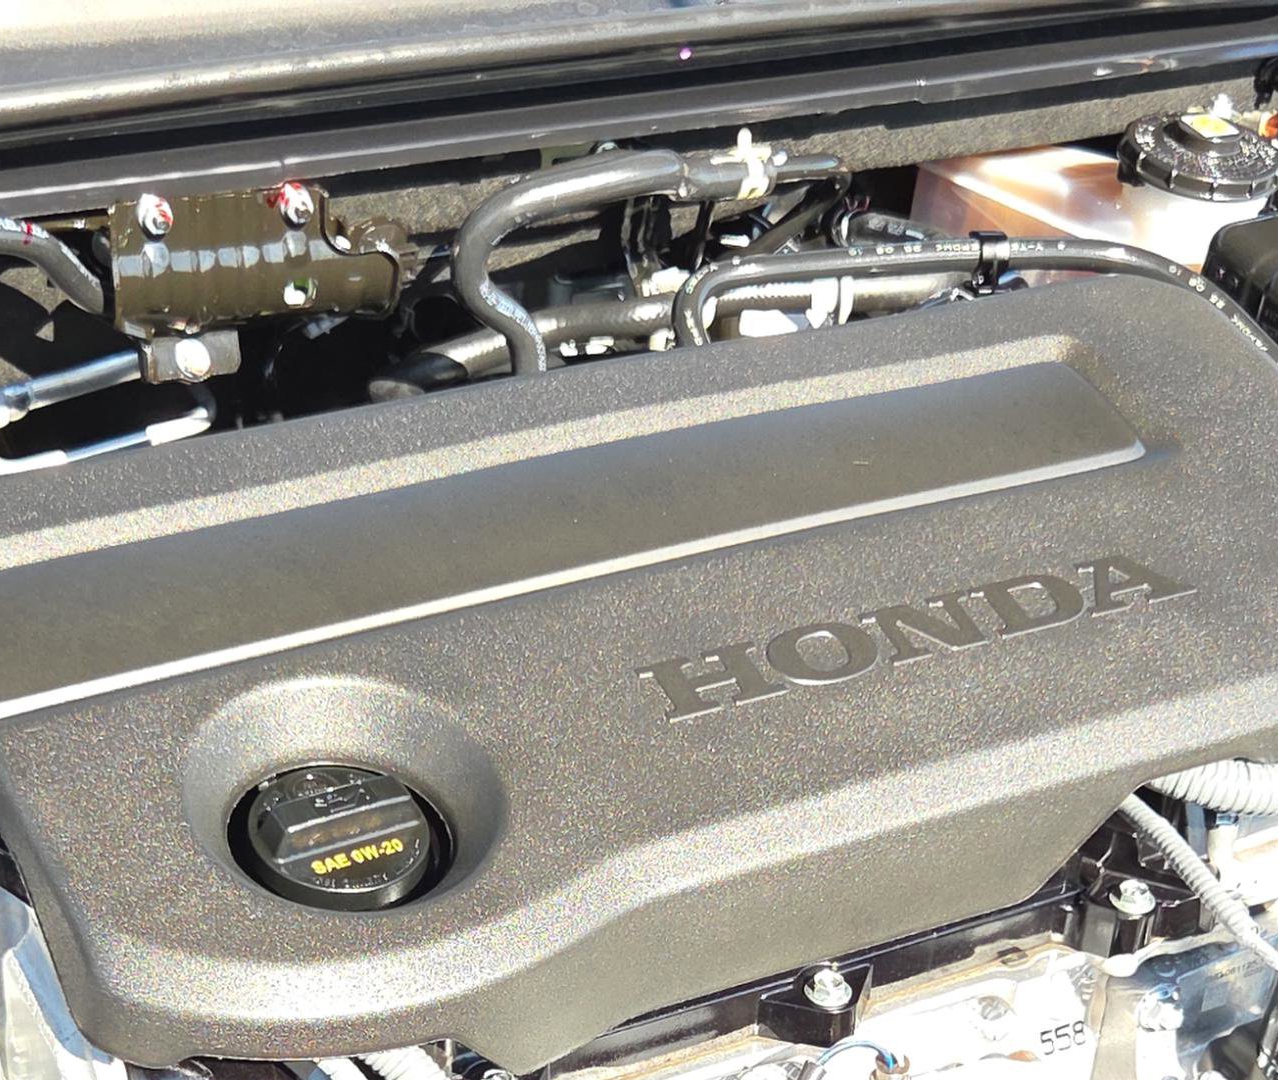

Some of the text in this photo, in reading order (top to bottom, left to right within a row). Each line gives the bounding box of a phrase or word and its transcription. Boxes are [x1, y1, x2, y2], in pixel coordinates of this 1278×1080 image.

[635, 554, 1198, 724] HONDA
[311, 837, 405, 875] SAE 0W-20
[1039, 1019, 1086, 1056] 558
